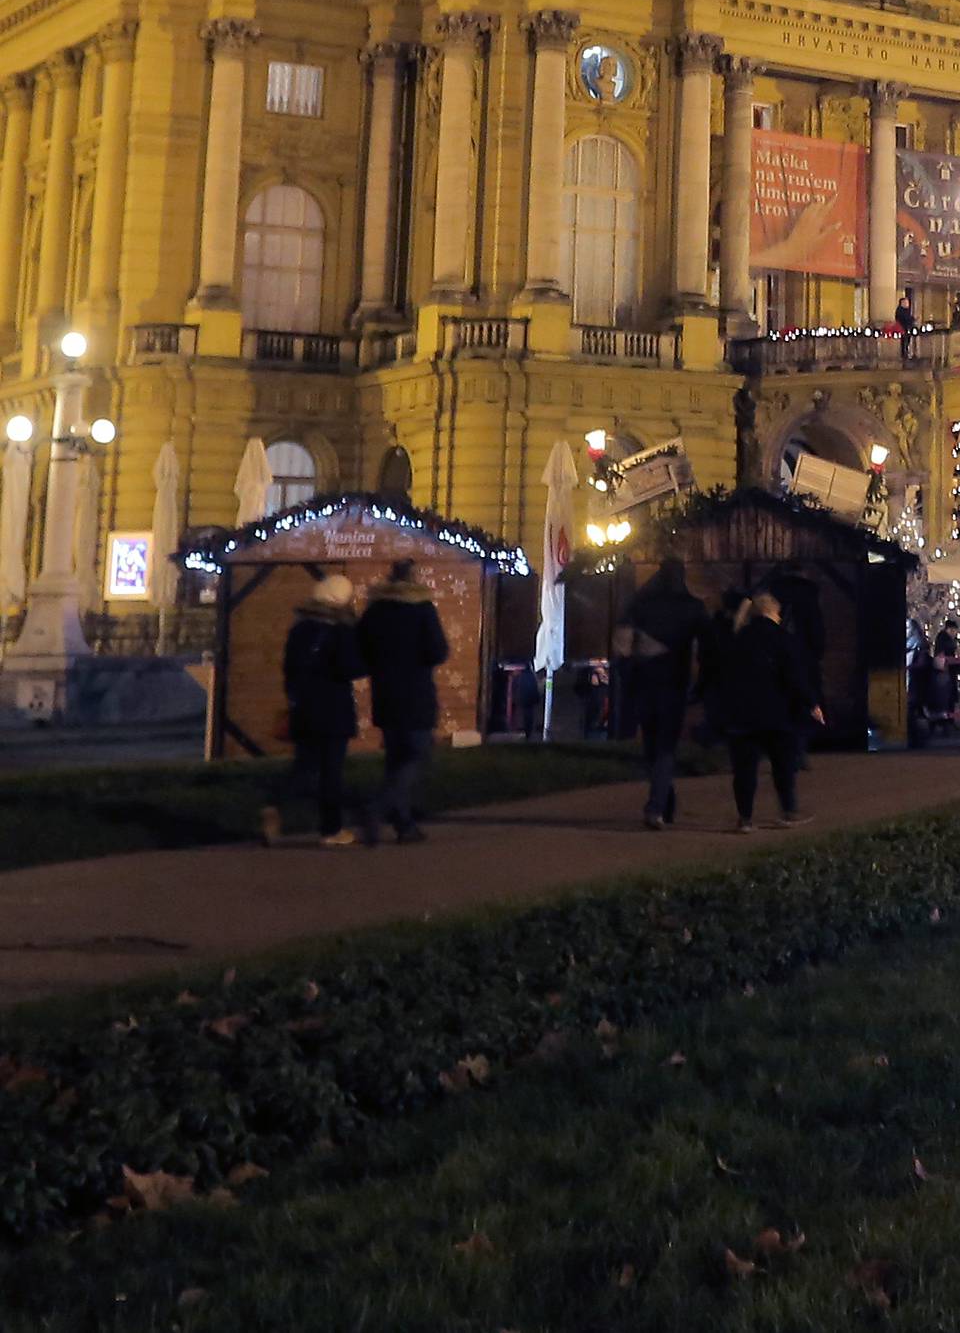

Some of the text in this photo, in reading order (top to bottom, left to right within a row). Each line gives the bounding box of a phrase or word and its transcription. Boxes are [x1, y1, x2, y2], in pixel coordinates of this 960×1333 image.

[783, 32, 888, 61] HRVATSKO
[755, 150, 809, 171] Mačka
[755, 170, 775, 182] na
[928, 217, 960, 235] na
